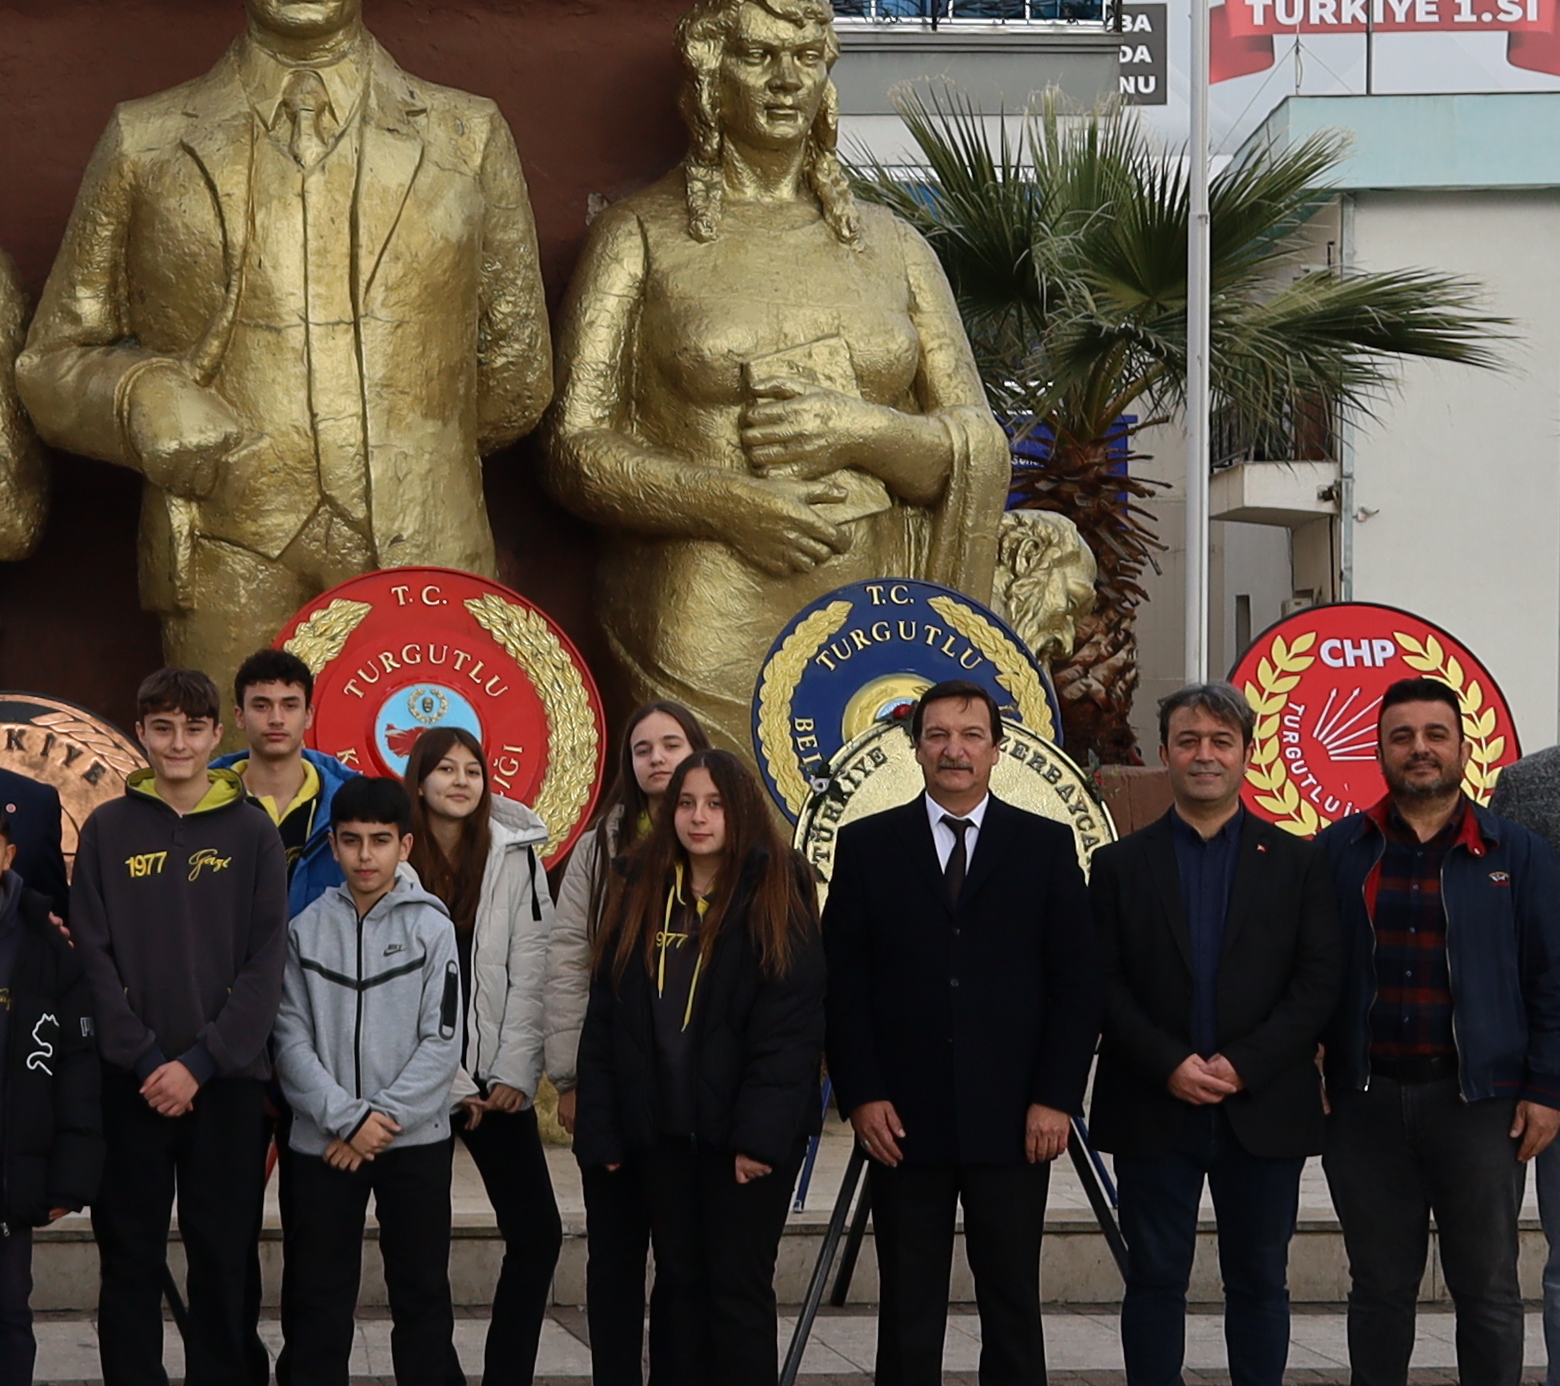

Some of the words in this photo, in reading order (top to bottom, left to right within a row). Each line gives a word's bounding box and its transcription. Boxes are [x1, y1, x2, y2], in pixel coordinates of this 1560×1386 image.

[342, 643, 510, 700] TURGUTLU
[815, 620, 983, 673] TURGUTLU
[1319, 638, 1396, 668] CHP
[1282, 702, 1341, 813] TURGUTLU
[125, 850, 168, 878] 1977
